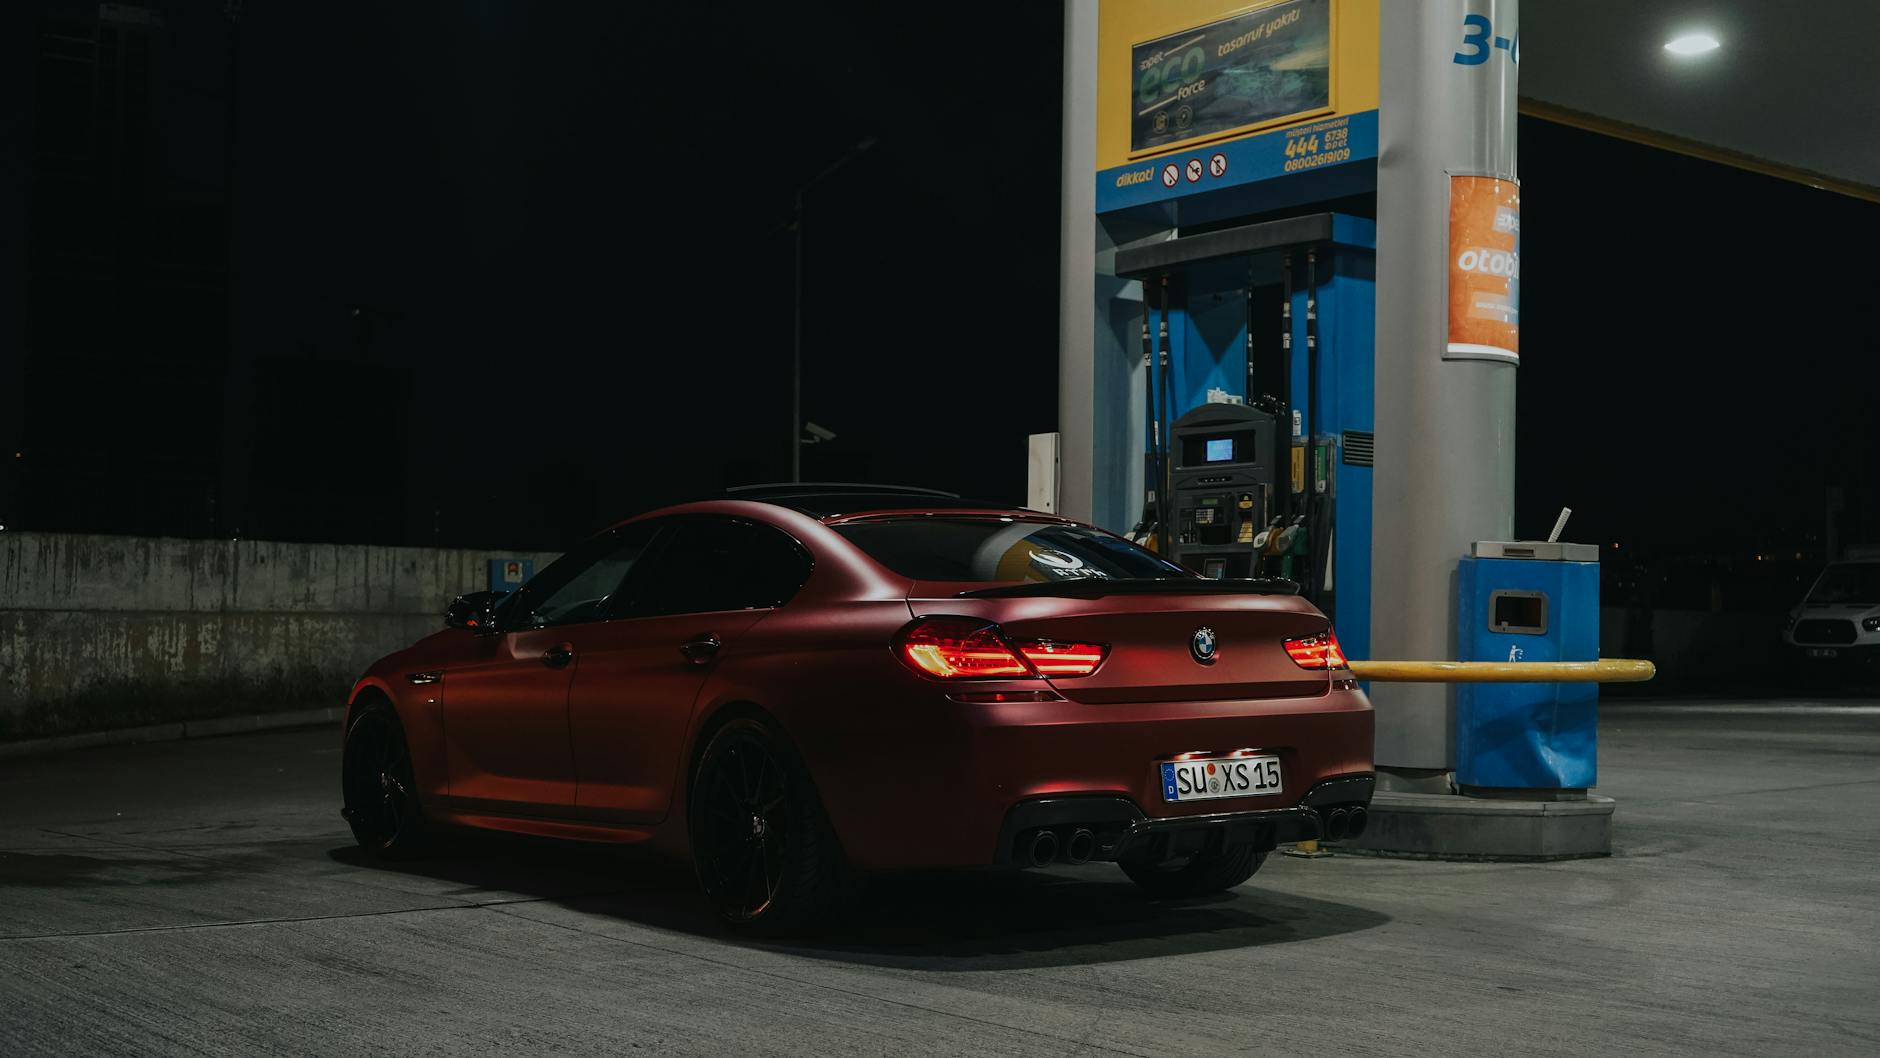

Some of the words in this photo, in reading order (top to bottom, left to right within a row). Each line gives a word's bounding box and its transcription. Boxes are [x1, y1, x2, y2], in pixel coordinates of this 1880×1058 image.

[1217, 24, 1264, 57] tasarruf
[1453, 14, 1518, 65] 3-
[1139, 46, 1206, 103] eco
[1177, 79, 1206, 101] force
[1284, 134, 1319, 158] 444
[1325, 127, 1348, 142] 6738
[1284, 148, 1350, 172] 08002619109
[1177, 766, 1208, 794] SU
[1221, 763, 1250, 790] XS
[1254, 761, 1279, 789] 15
